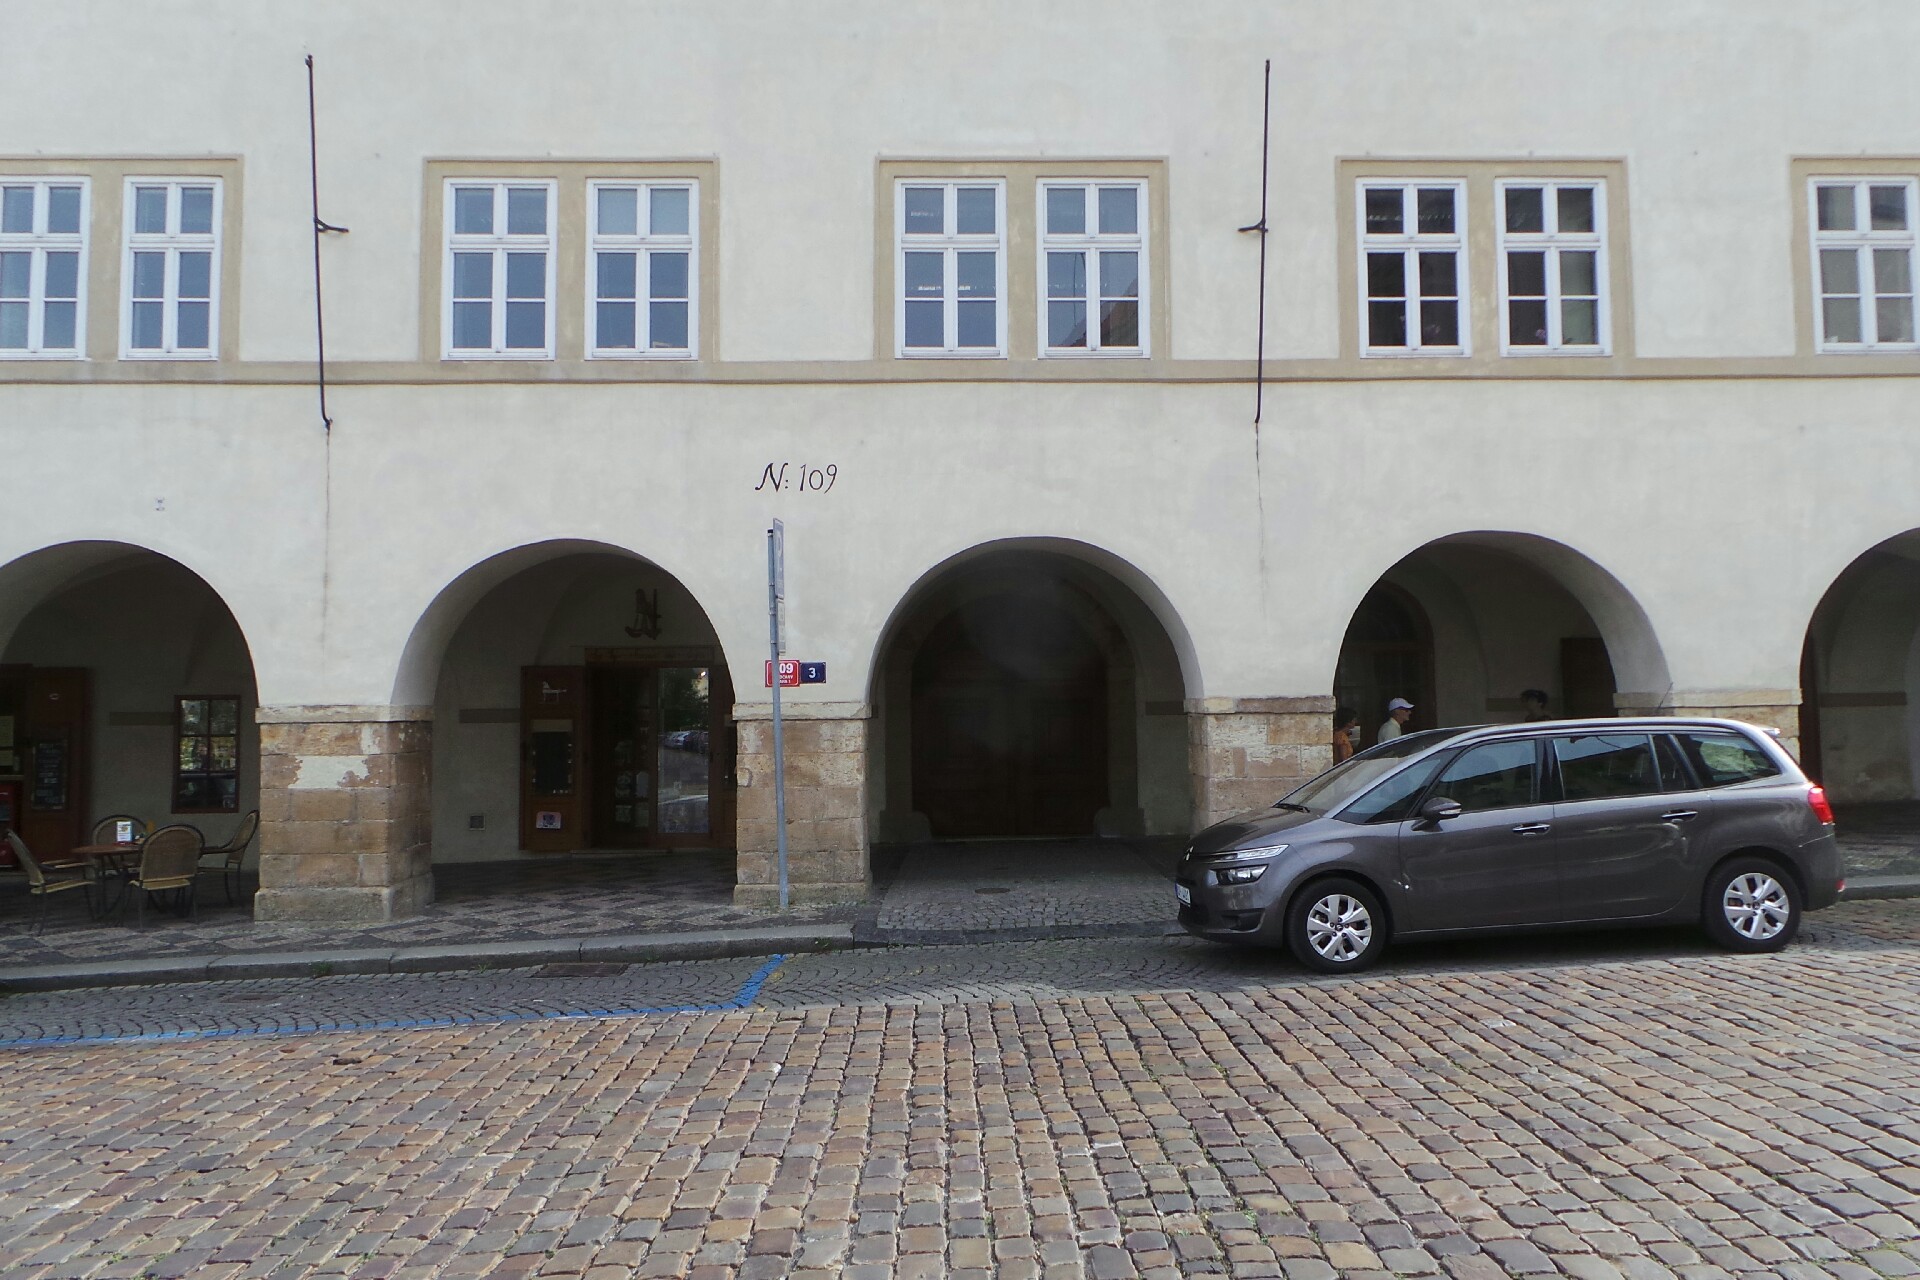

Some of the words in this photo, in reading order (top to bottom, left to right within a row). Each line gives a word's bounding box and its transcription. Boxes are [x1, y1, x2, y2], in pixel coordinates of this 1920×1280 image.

[799, 463, 838, 494] 109
[778, 663, 794, 674] 09
[808, 667, 817, 679] 3
